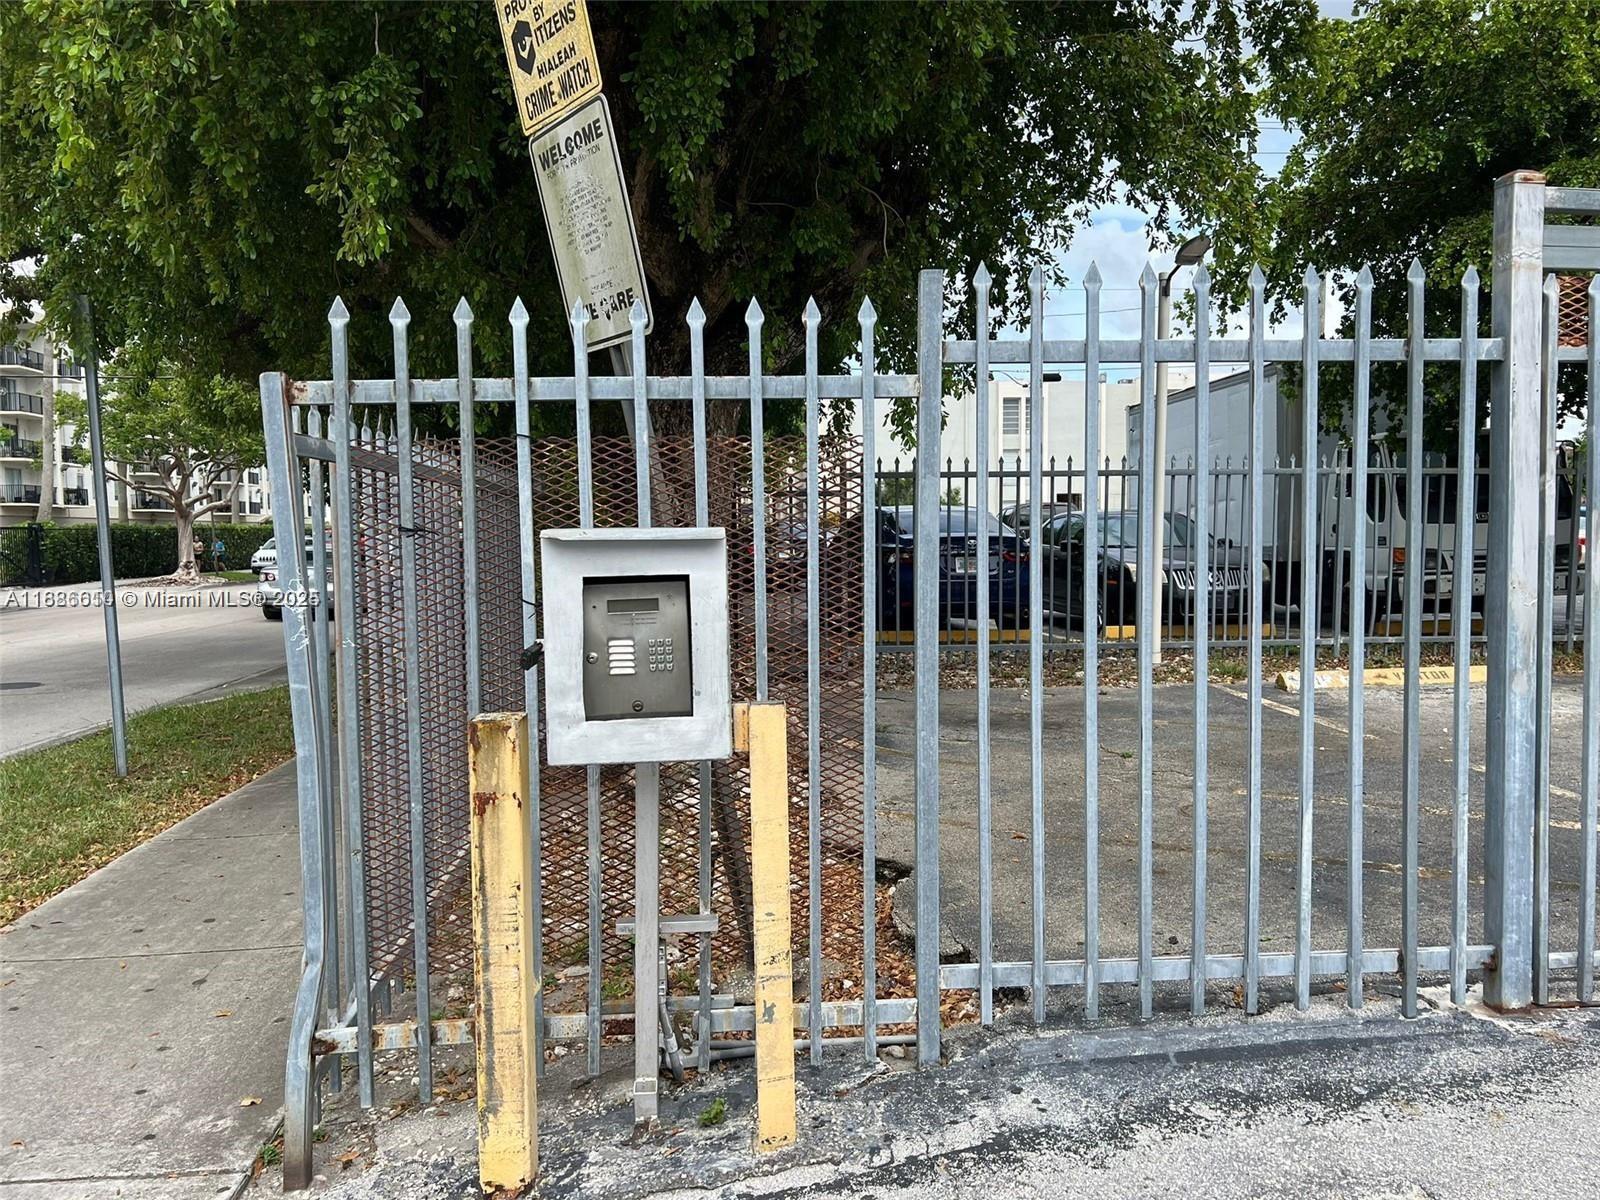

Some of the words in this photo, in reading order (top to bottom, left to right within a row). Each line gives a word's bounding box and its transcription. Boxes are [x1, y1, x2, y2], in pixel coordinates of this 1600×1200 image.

[533, 4, 545, 22] BY
[537, 41, 577, 79] HIALEAH
[525, 80, 558, 122] CRIME
[558, 57, 592, 101] WATCH
[538, 118, 604, 172] WELCOME
